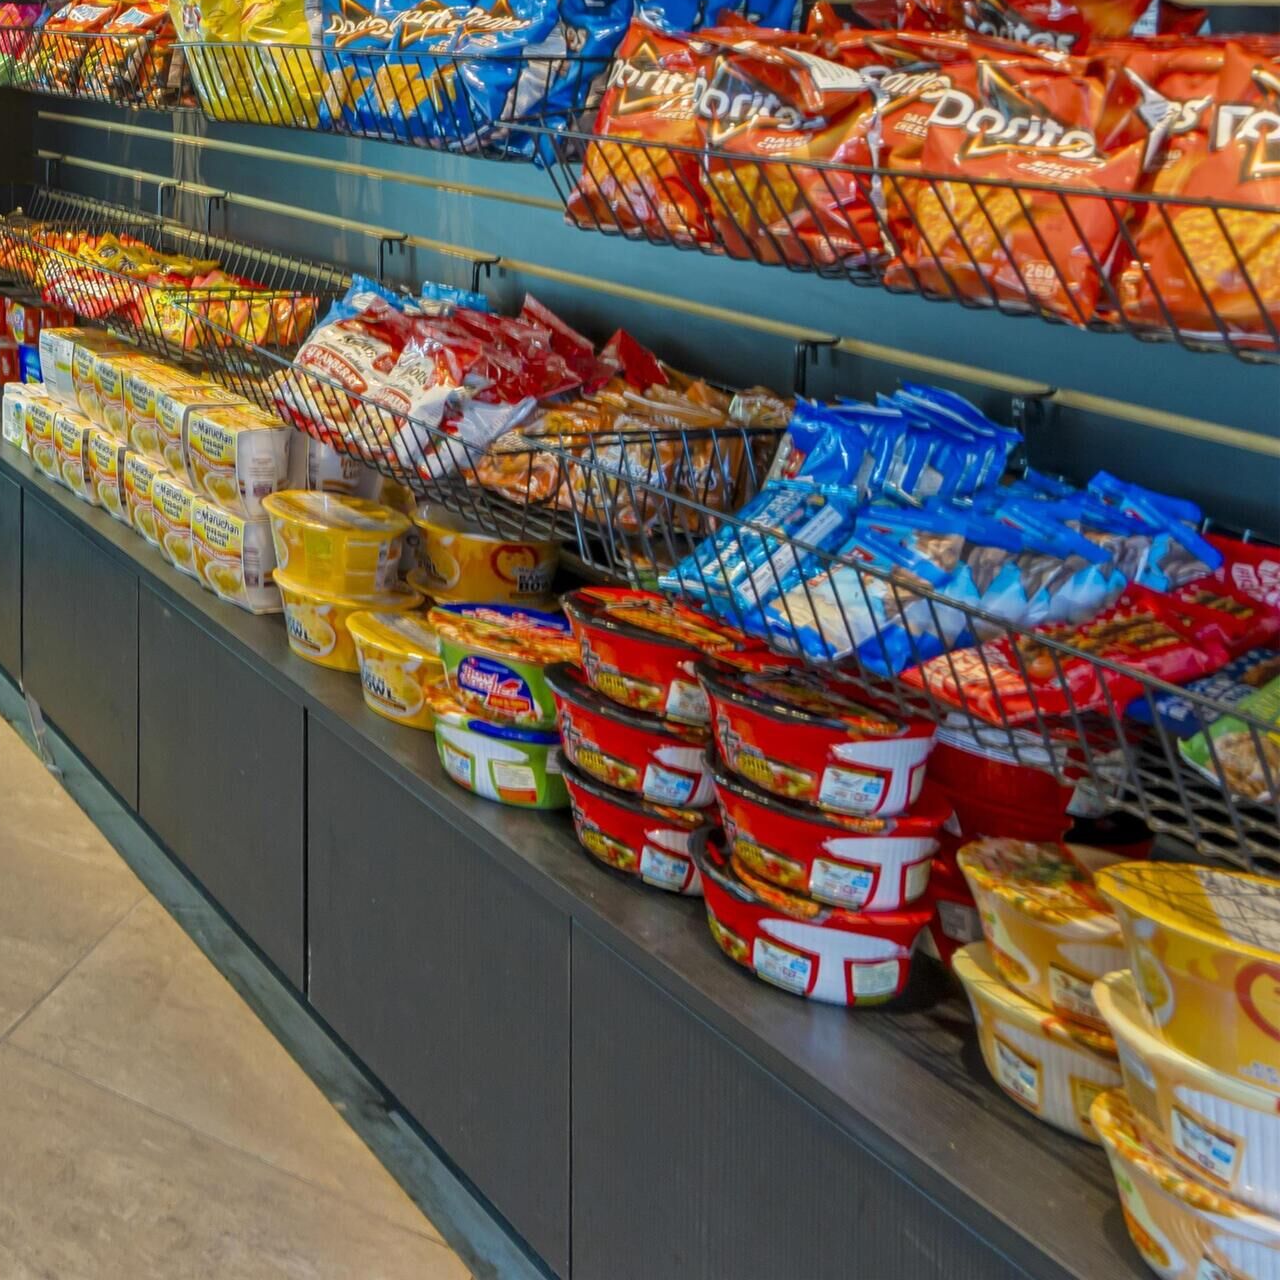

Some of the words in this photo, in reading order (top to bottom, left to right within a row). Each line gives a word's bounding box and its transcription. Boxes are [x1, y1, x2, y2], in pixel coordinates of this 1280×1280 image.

[1026, 264, 1056, 279] 260
[198, 422, 233, 446] Maruchan
[159, 483, 192, 507] Maruchan
[201, 509, 240, 537] Maruchan
